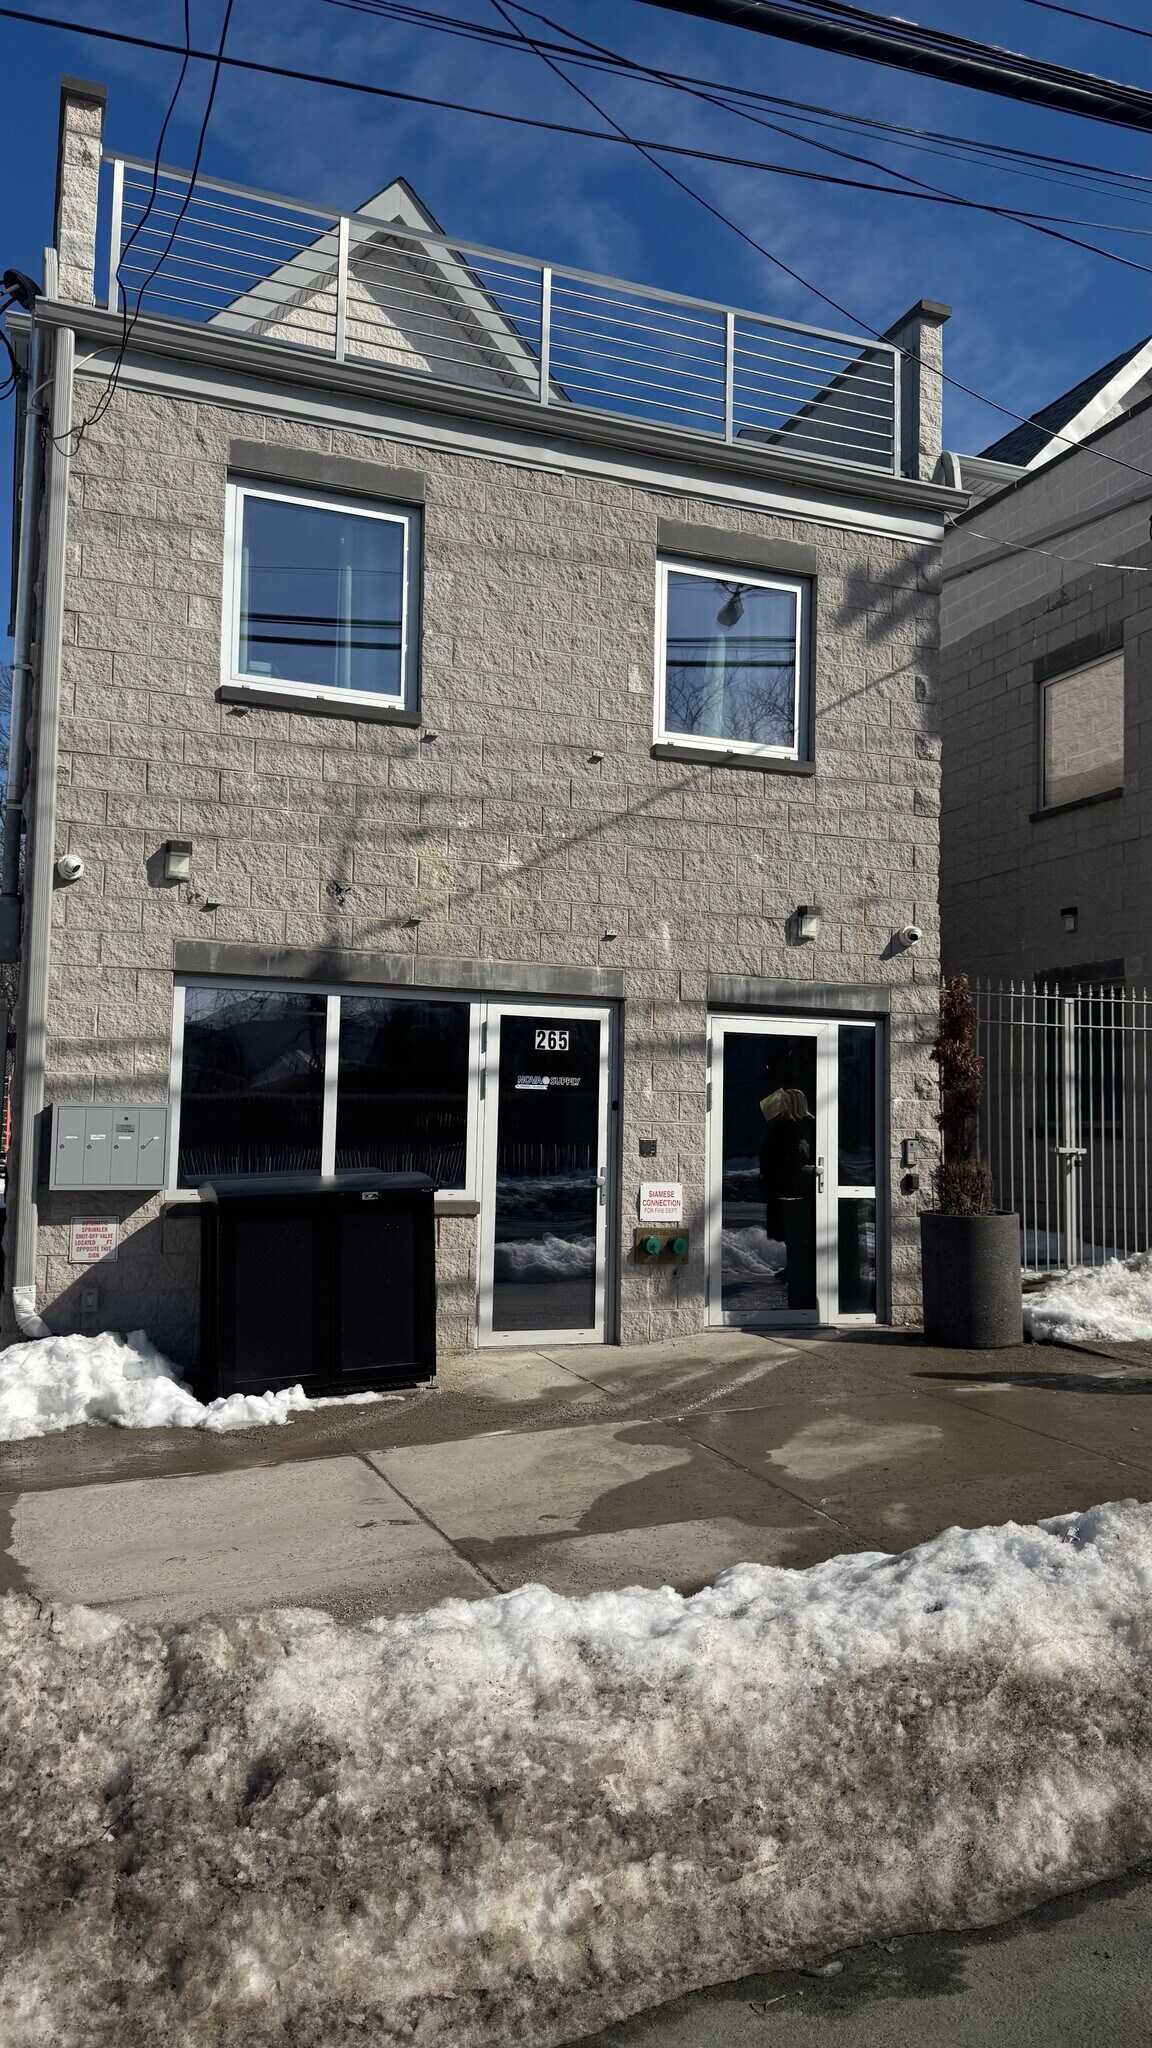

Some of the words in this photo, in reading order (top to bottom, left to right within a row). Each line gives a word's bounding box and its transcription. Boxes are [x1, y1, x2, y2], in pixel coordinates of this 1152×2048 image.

[536, 1030, 568, 1050] 265
[517, 1076, 542, 1084] NOVA
[550, 1076, 581, 1086] SUPPLY
